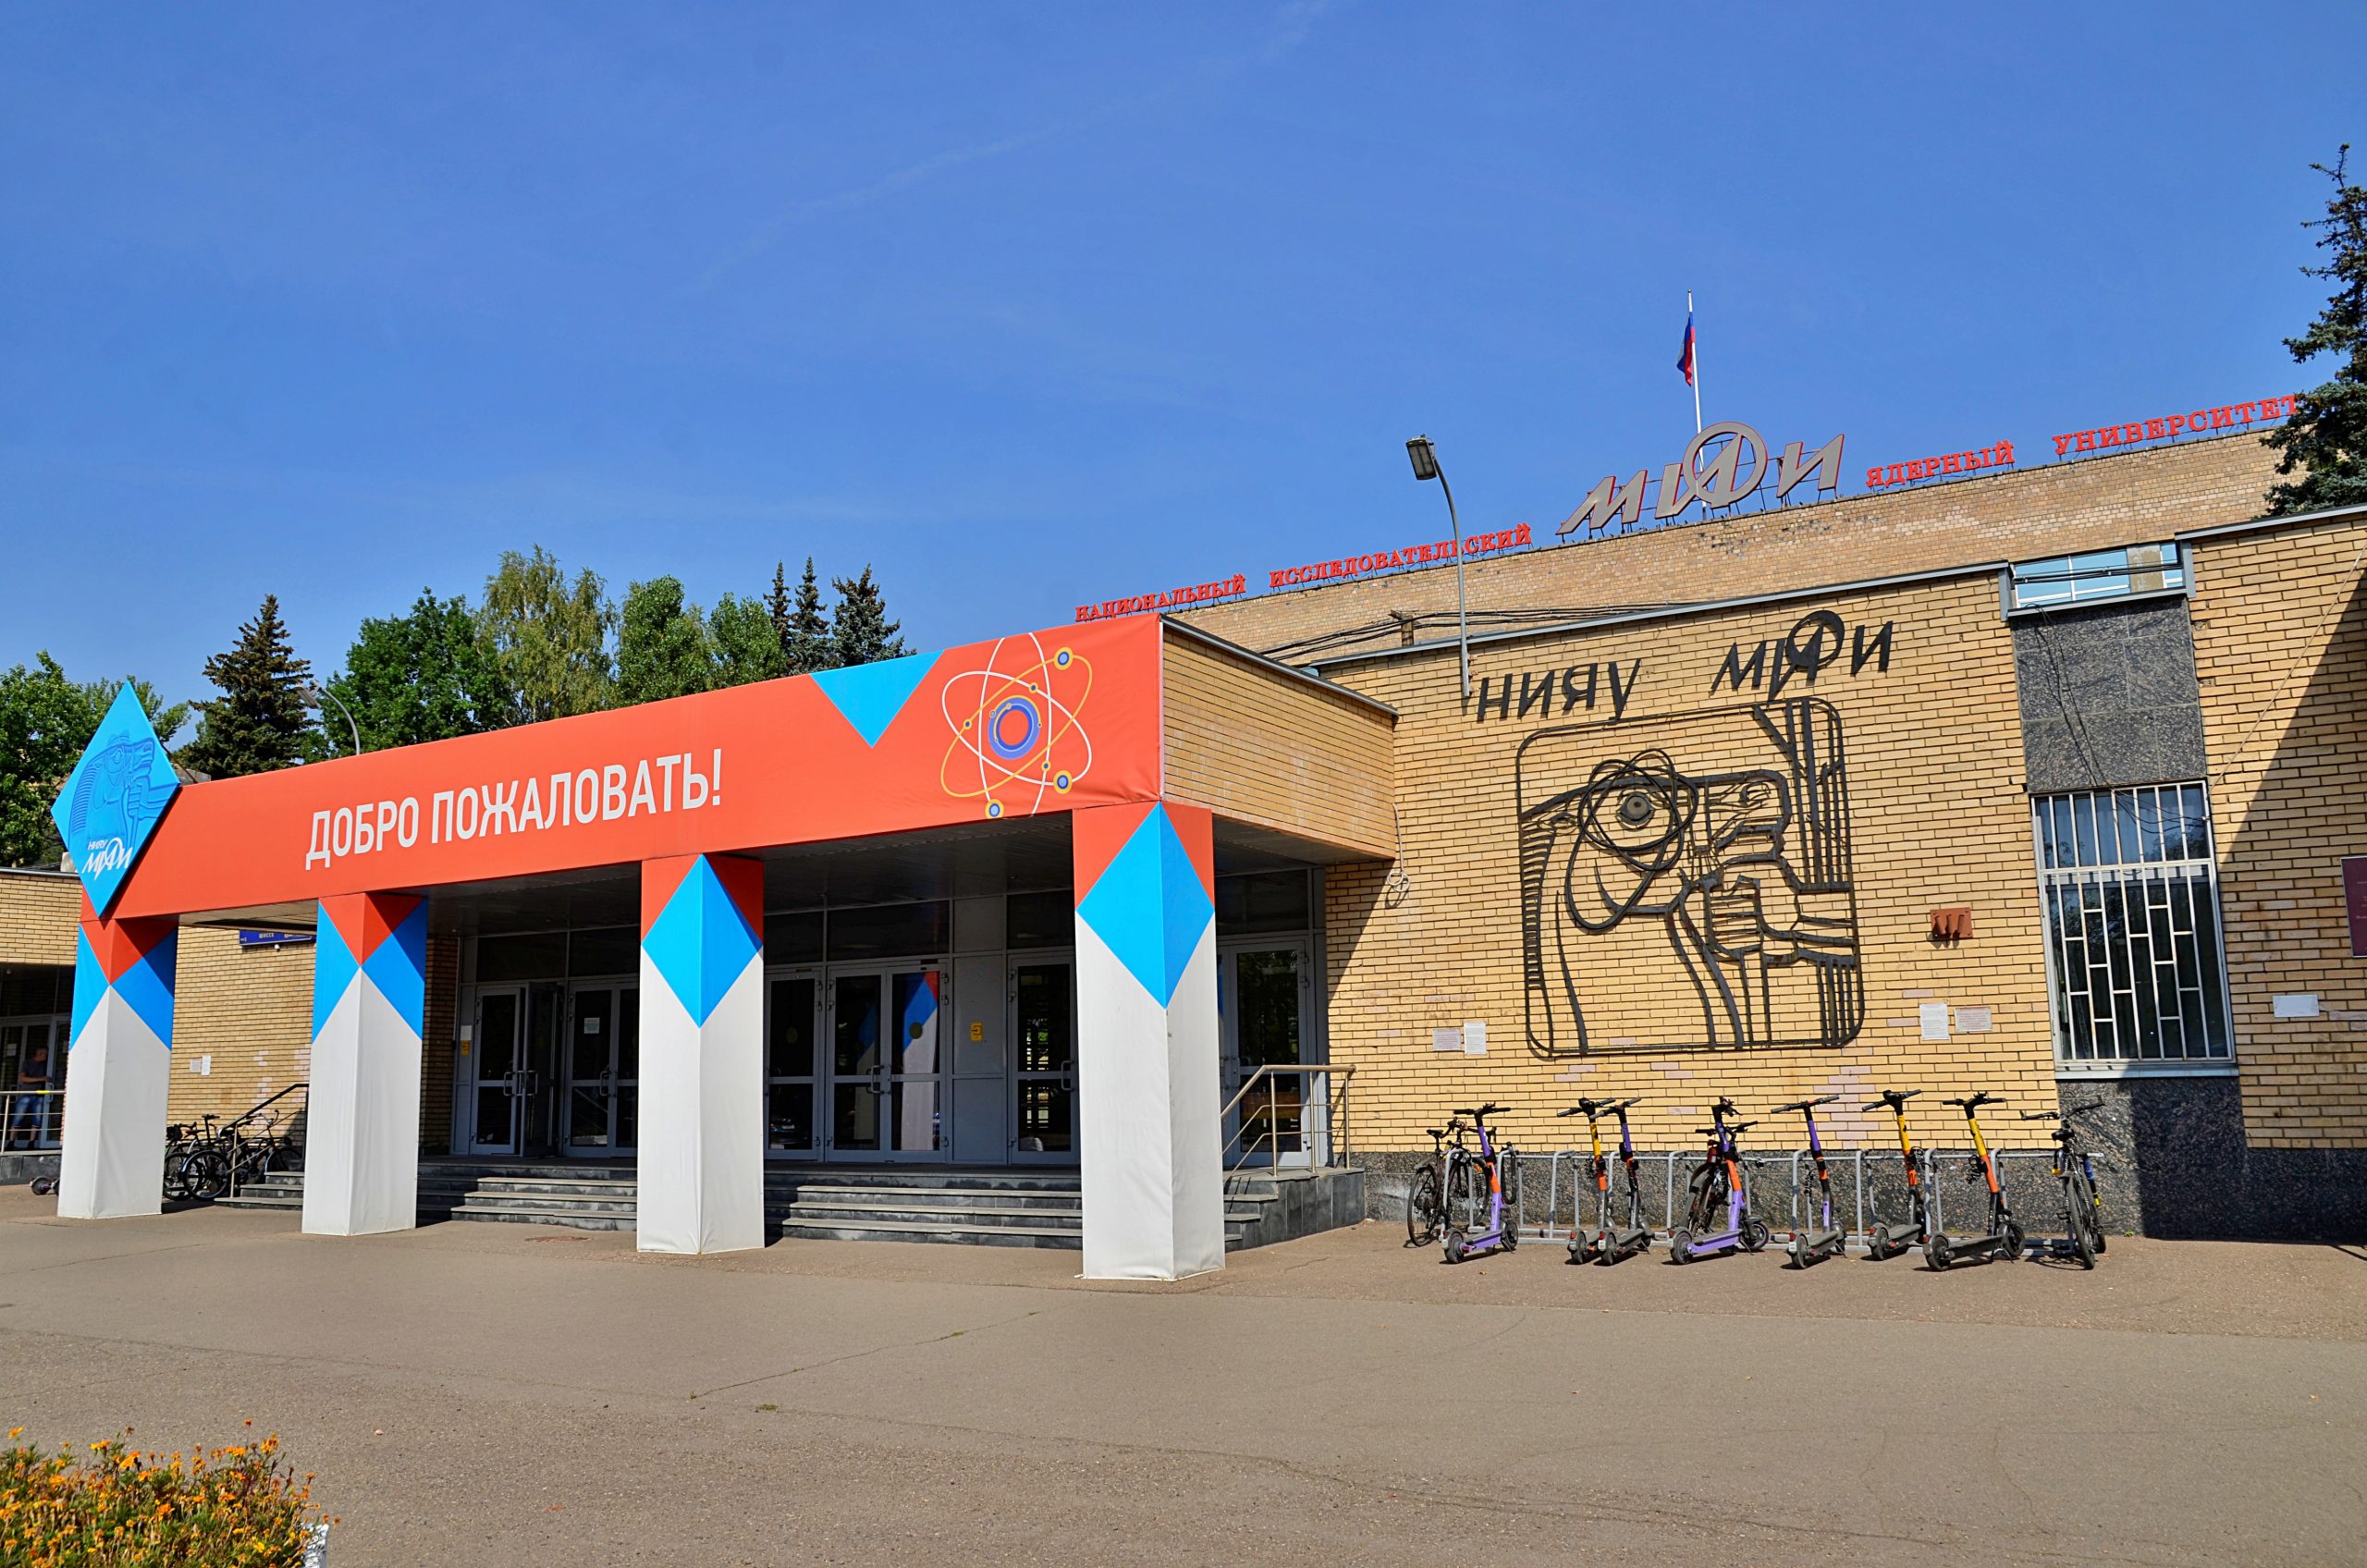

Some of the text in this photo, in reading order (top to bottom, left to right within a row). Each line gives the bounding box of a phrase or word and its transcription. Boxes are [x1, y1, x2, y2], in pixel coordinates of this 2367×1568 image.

[1556, 422, 1845, 535] МИФИ
[1866, 440, 2016, 487] ЯДЕРНЫЙ
[1075, 522, 1532, 622] НАЦИОНАЛЬНЫЙ ИССЛЕДОВАТЕЛЬСКИЙ
[1479, 610, 1894, 720] НИЯУ МИФИ
[81, 837, 133, 881] МИФИ
[305, 748, 722, 870] ДОБРО ПОЖАЛОВАТЬ!
